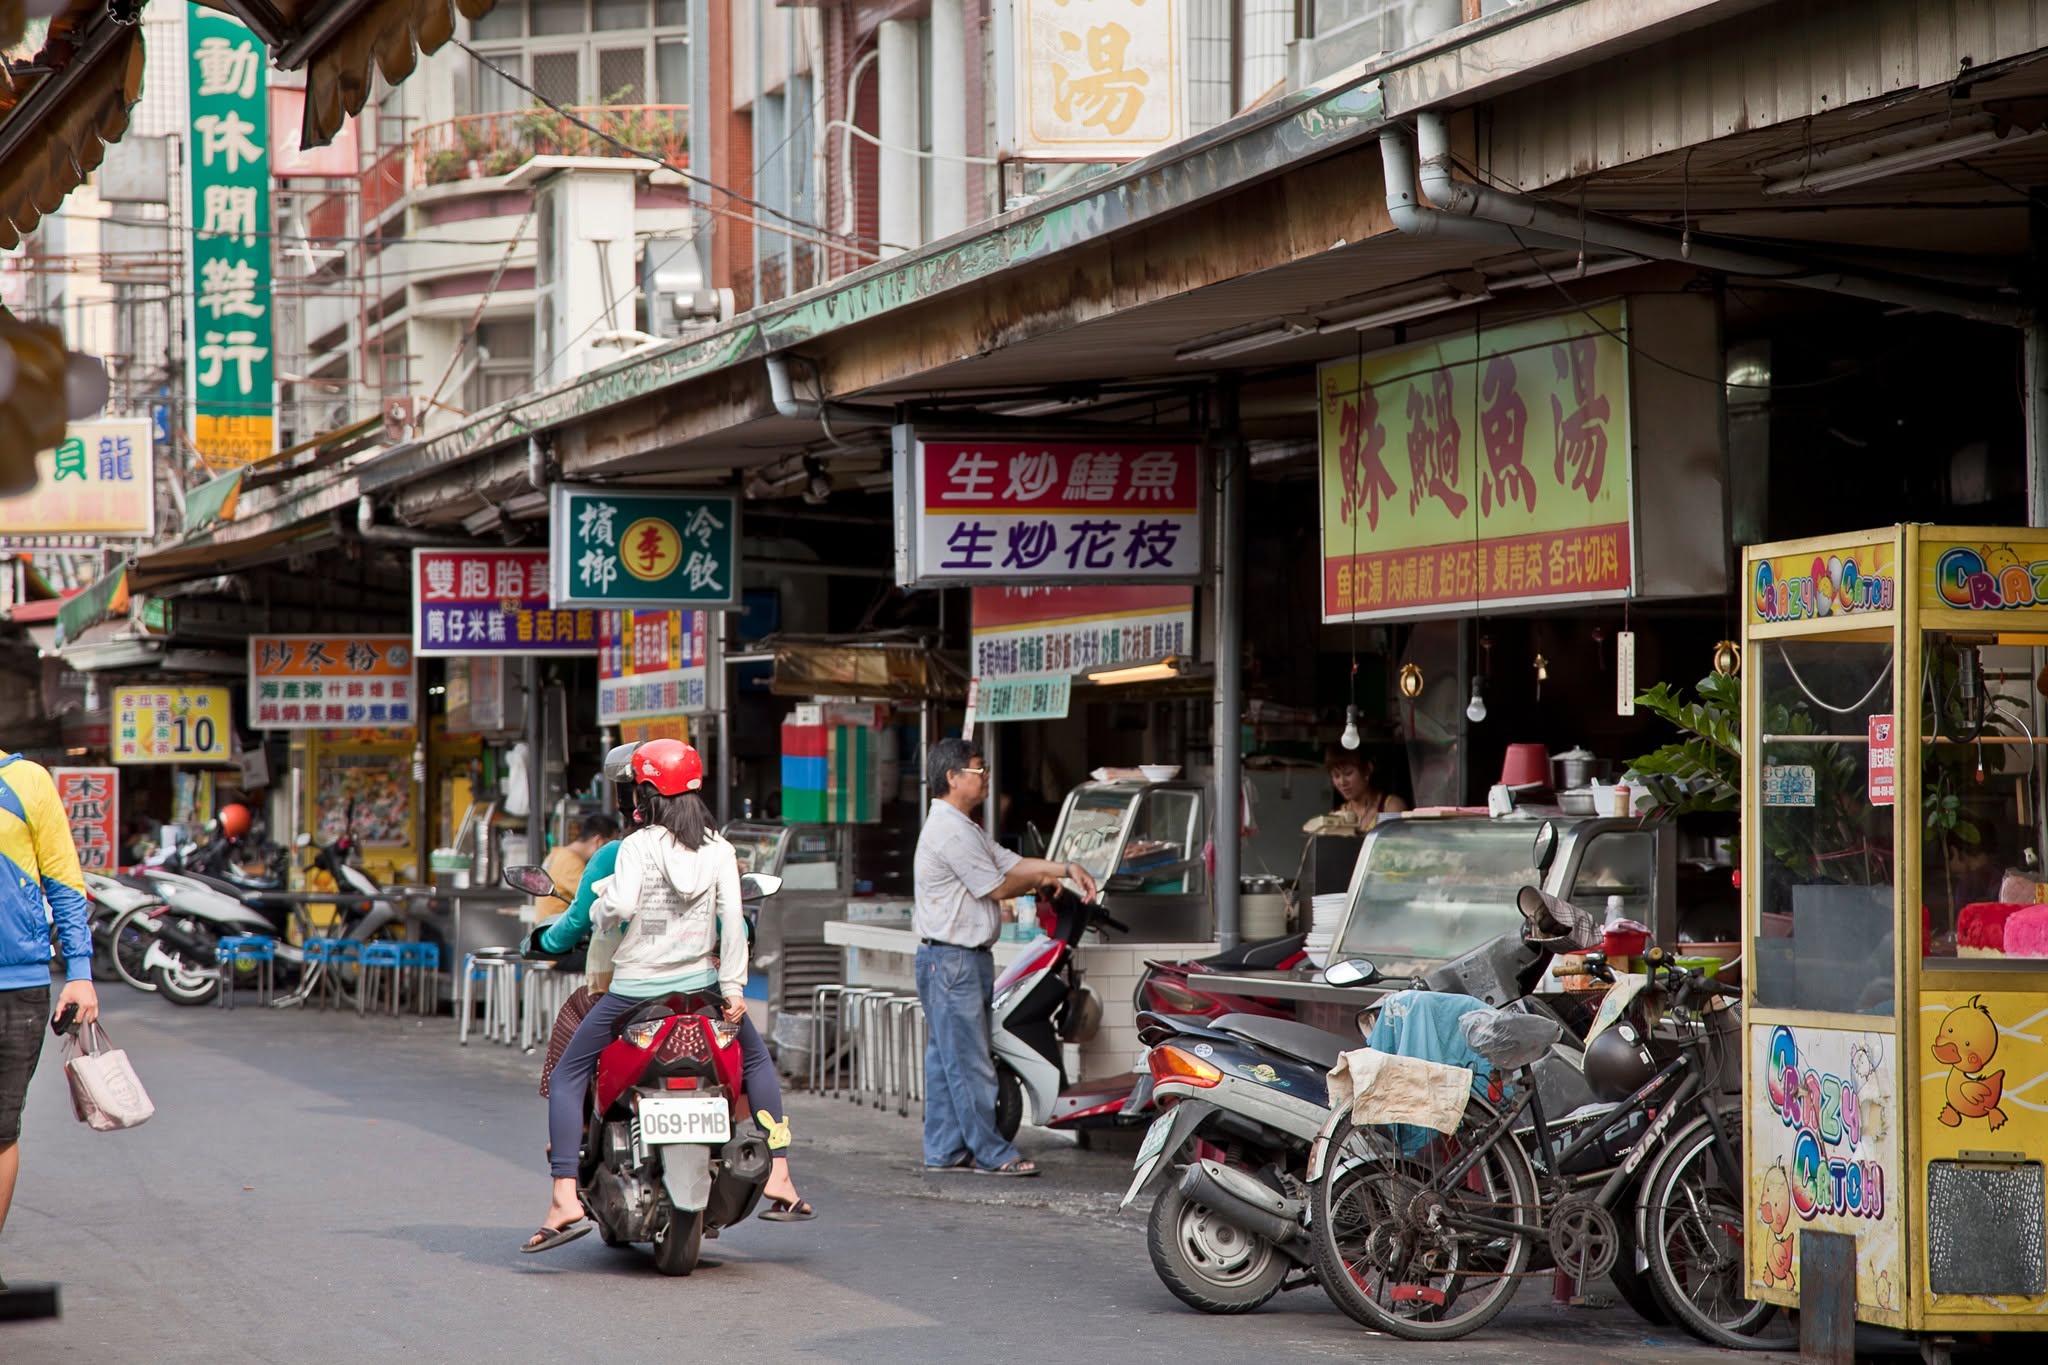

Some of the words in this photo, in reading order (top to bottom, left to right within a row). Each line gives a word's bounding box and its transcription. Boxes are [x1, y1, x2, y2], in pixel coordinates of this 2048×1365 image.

[1050, 0, 1149, 136] 湯
[193, 3, 268, 395] 動休閒鞋行
[941, 451, 1178, 501] 生炒鱔魚
[940, 519, 1181, 569] 生炒花枝
[1549, 532, 1618, 586] 各式切料
[427, 609, 507, 643] 筒仔米糕
[260, 640, 380, 674] 炒冬粉
[172, 715, 215, 753] 10
[644, 1112, 726, 1135] 069-PMB
